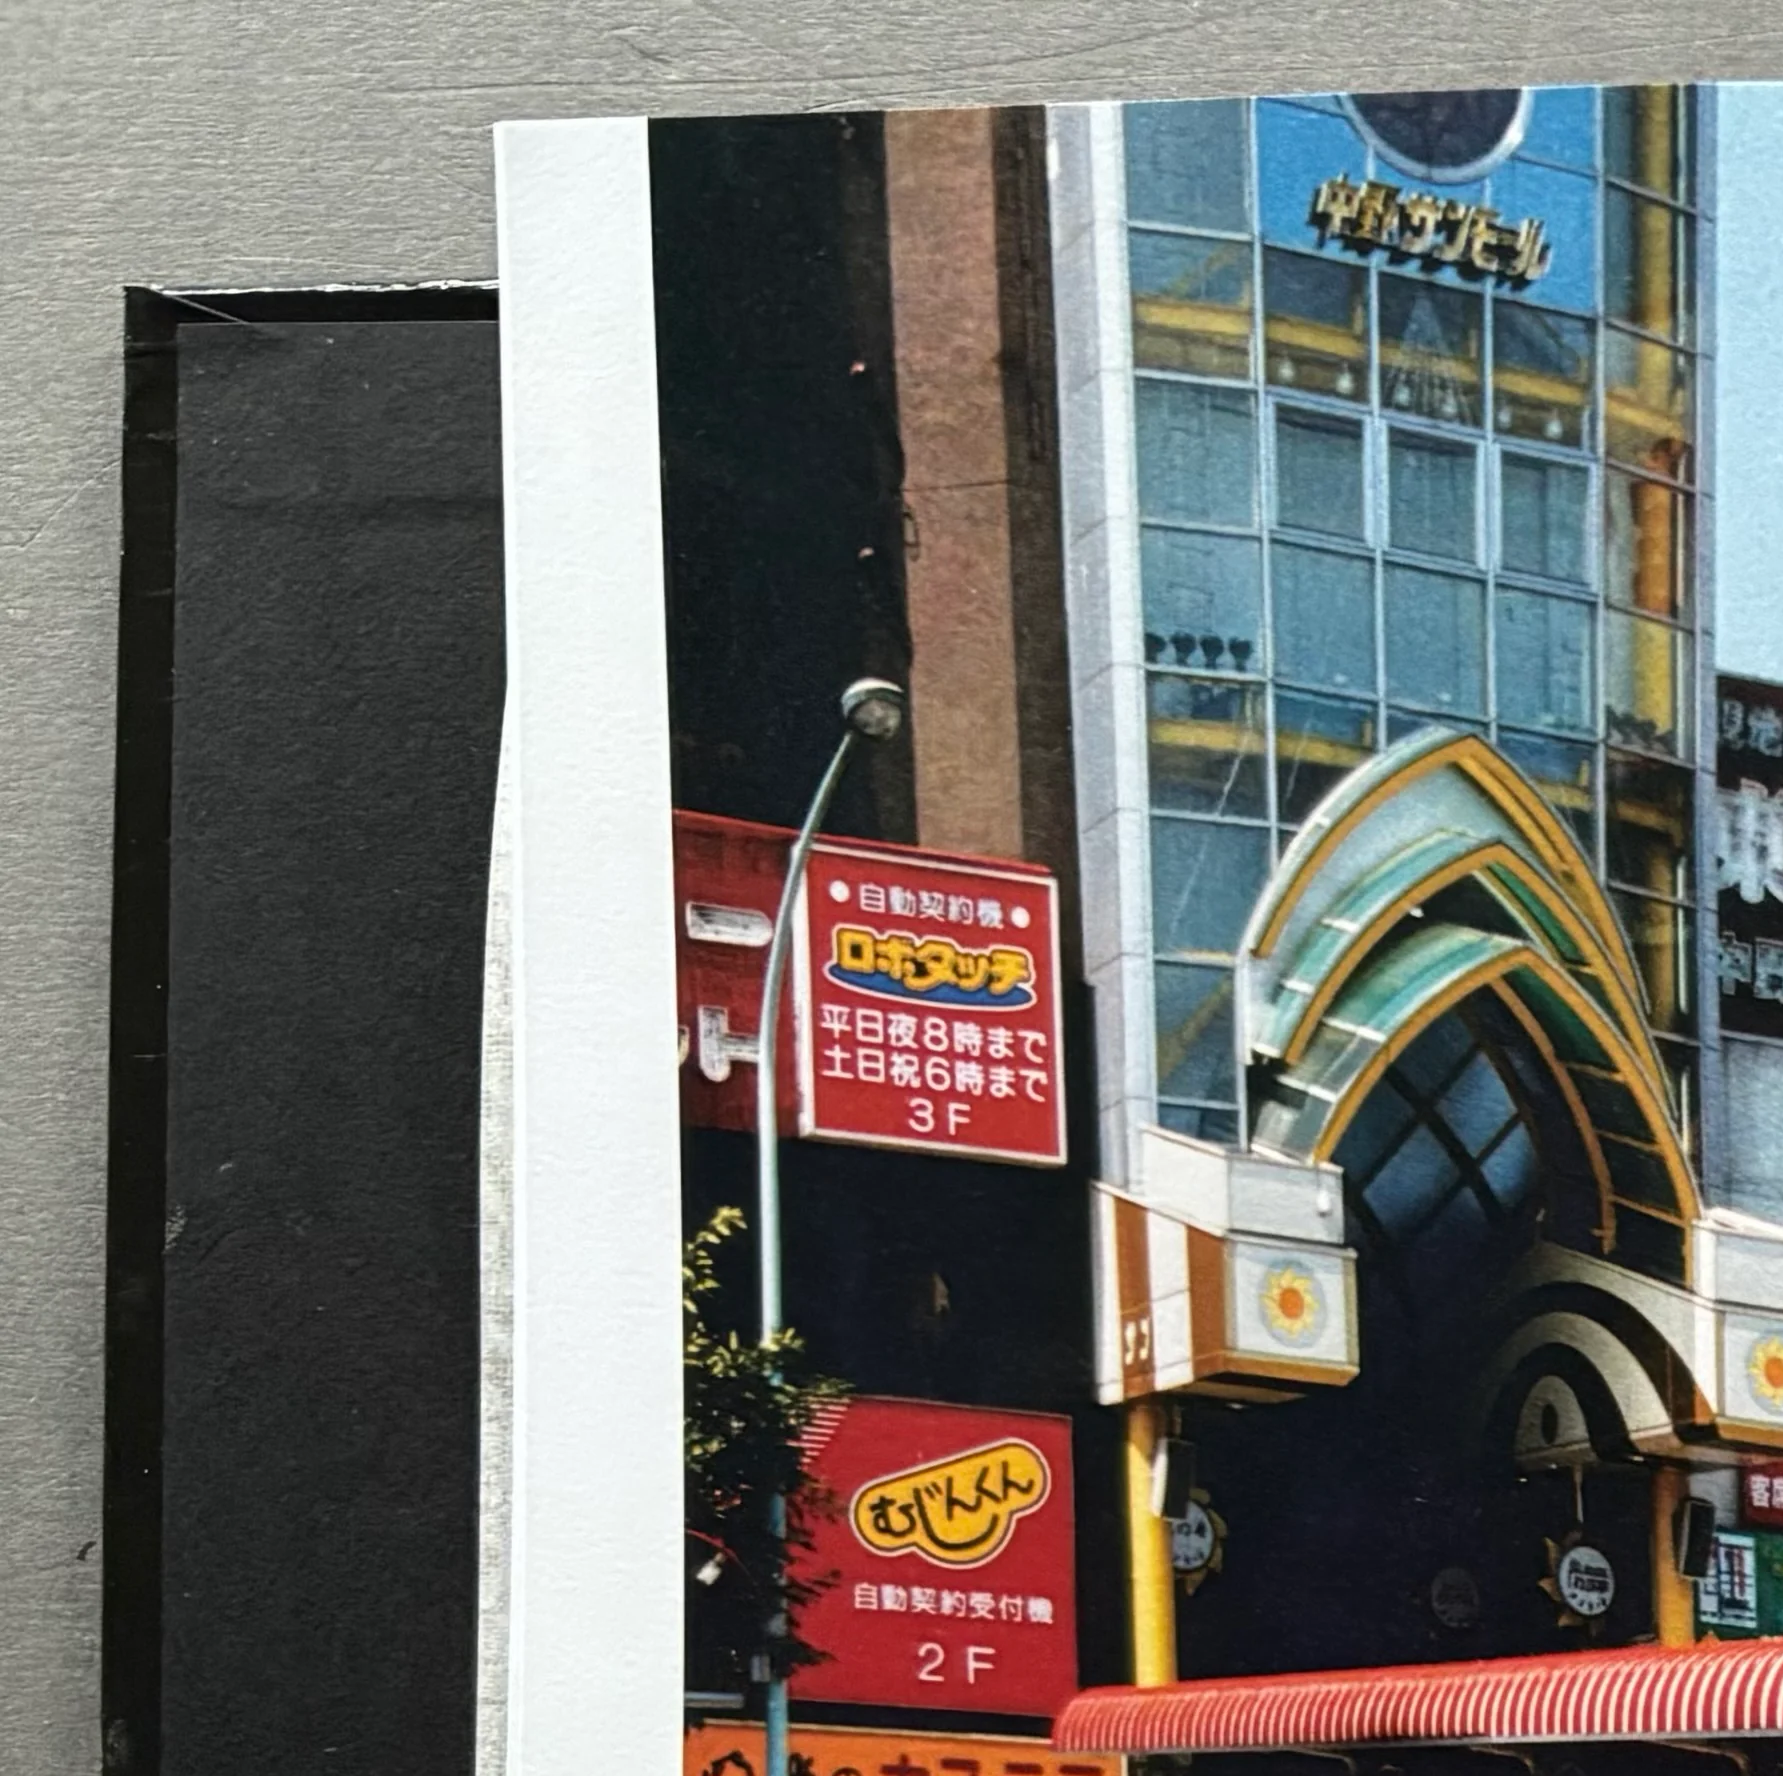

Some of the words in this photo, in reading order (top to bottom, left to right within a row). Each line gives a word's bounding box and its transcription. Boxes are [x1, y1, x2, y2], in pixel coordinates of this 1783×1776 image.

[858, 882, 1004, 930] 自動契約機
[836, 929, 1032, 991] ロボタッチ
[820, 1004, 1049, 1064] 平日夜8時まで
[821, 1045, 1049, 1103] 土日祝6時まで
[907, 1100, 971, 1136] 3F
[869, 1459, 1036, 1550] むじんくん
[853, 1582, 1054, 1625] 自動契約受付機
[917, 1643, 997, 1684] 2F
